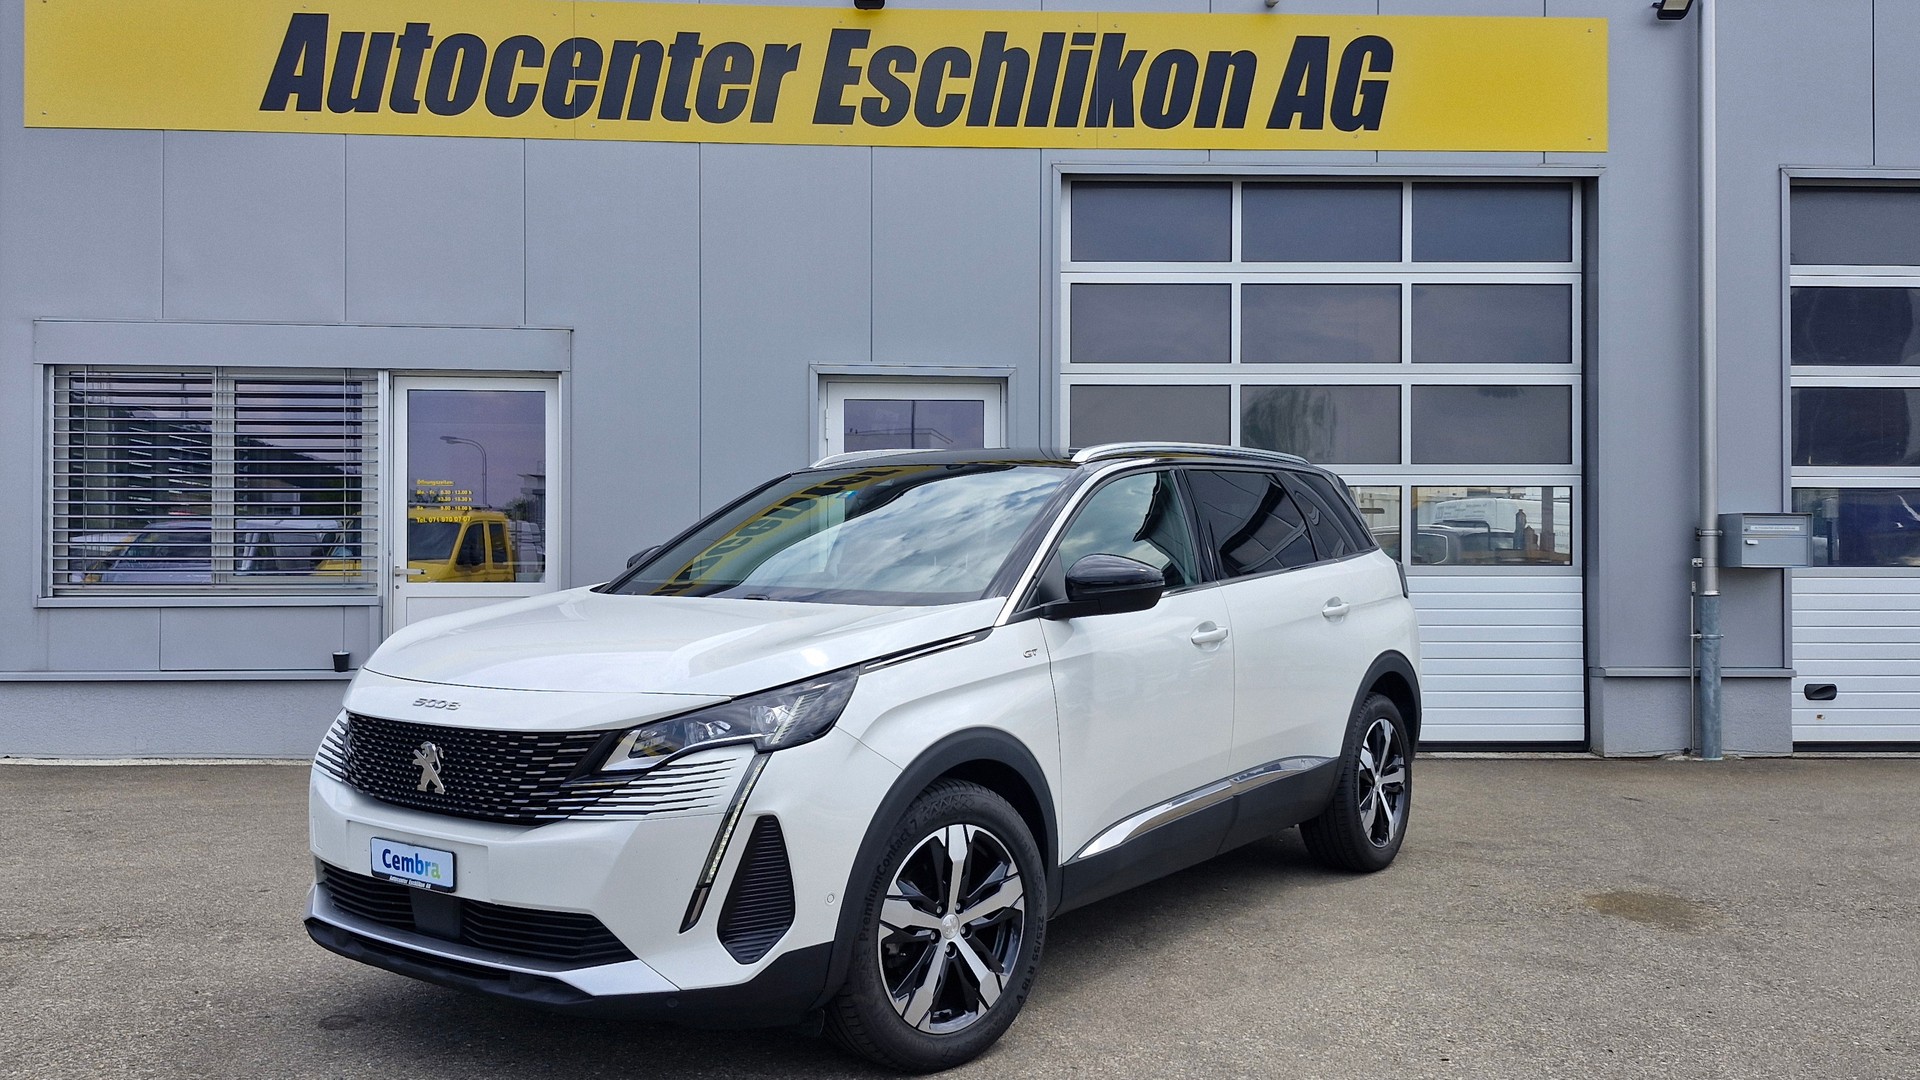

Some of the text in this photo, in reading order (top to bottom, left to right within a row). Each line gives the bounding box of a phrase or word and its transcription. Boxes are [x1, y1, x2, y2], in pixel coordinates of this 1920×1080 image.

[259, 13, 1393, 132] Autocenter Eschlikon AG
[1023, 648, 1038, 659] GT
[382, 848, 441, 880] Cembra
[857, 817, 919, 943] PremiumContact 7
